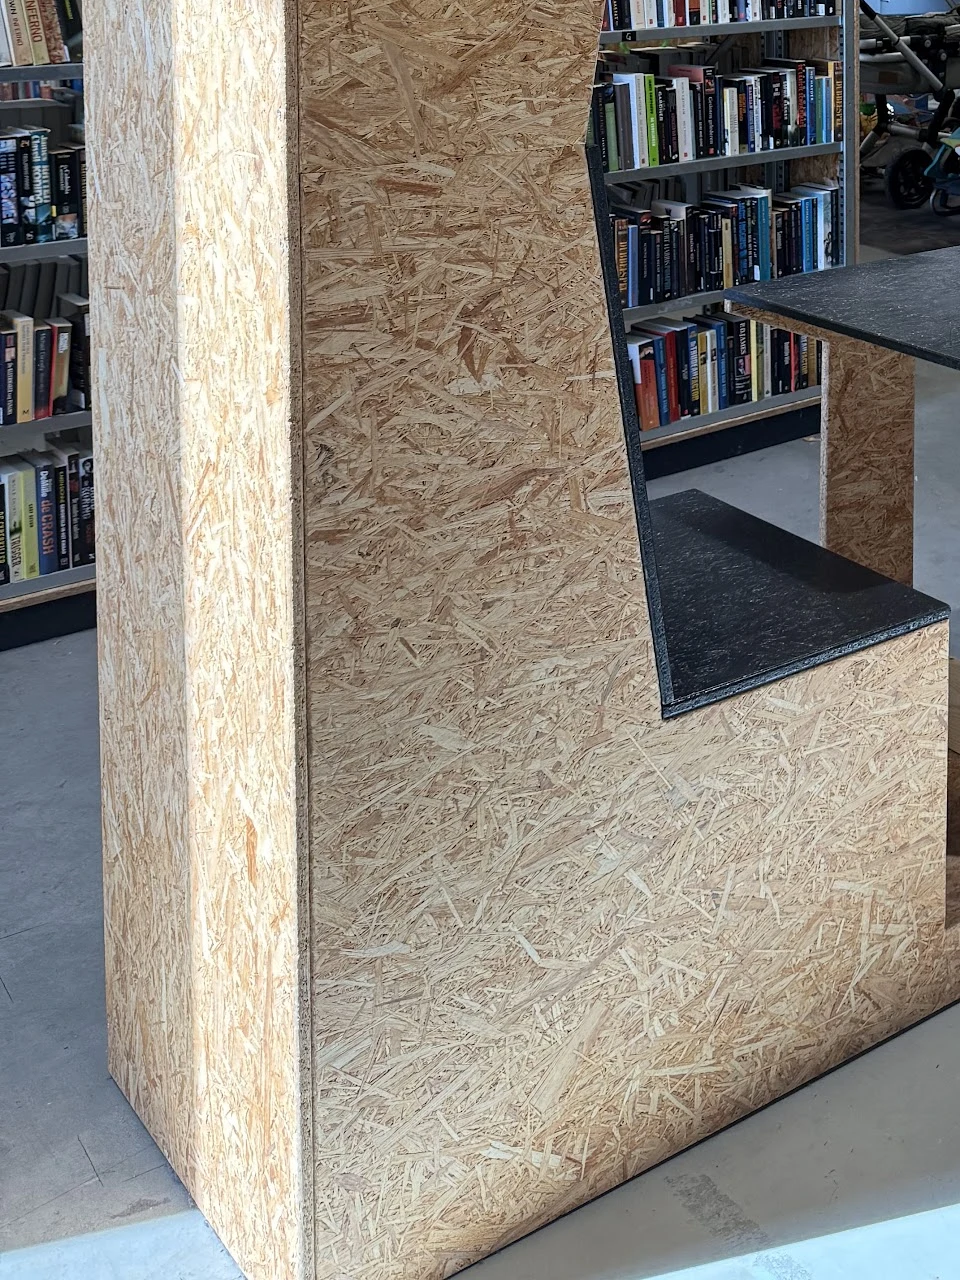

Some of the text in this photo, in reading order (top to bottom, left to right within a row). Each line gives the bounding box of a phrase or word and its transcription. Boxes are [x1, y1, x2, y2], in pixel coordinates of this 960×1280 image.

[619, 241, 627, 292] DUBBELSPEL
[40, 471, 48, 497] DeMille
[41, 500, 54, 555] de CRASH
[10, 535, 22, 568] TRIGGER
